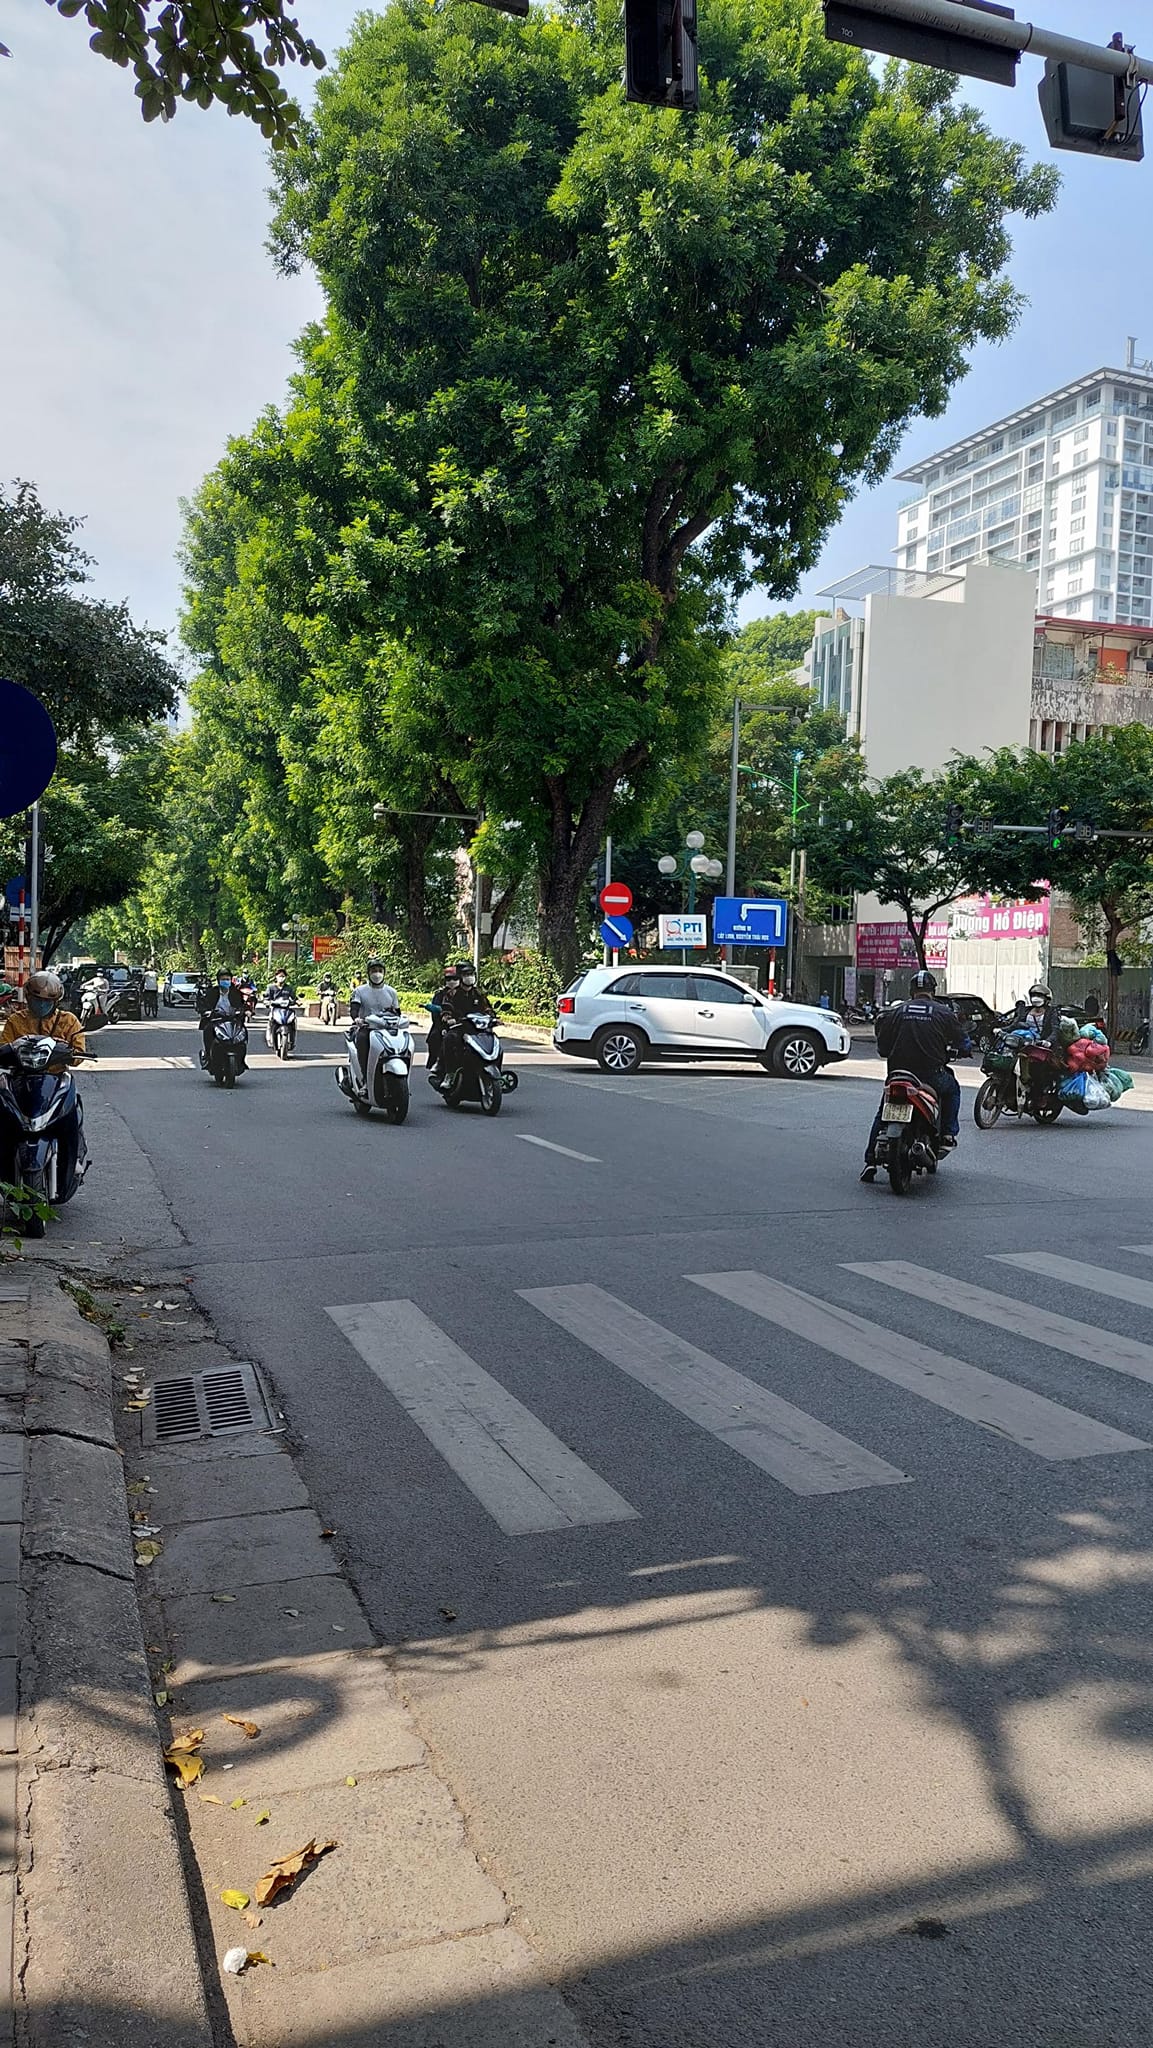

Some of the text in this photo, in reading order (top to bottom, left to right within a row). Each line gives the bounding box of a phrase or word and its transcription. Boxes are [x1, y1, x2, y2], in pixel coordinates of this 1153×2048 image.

[683, 922, 702, 933] PTI
[993, 910, 1010, 931] Hồ
[1013, 910, 1044, 933] Điệp
